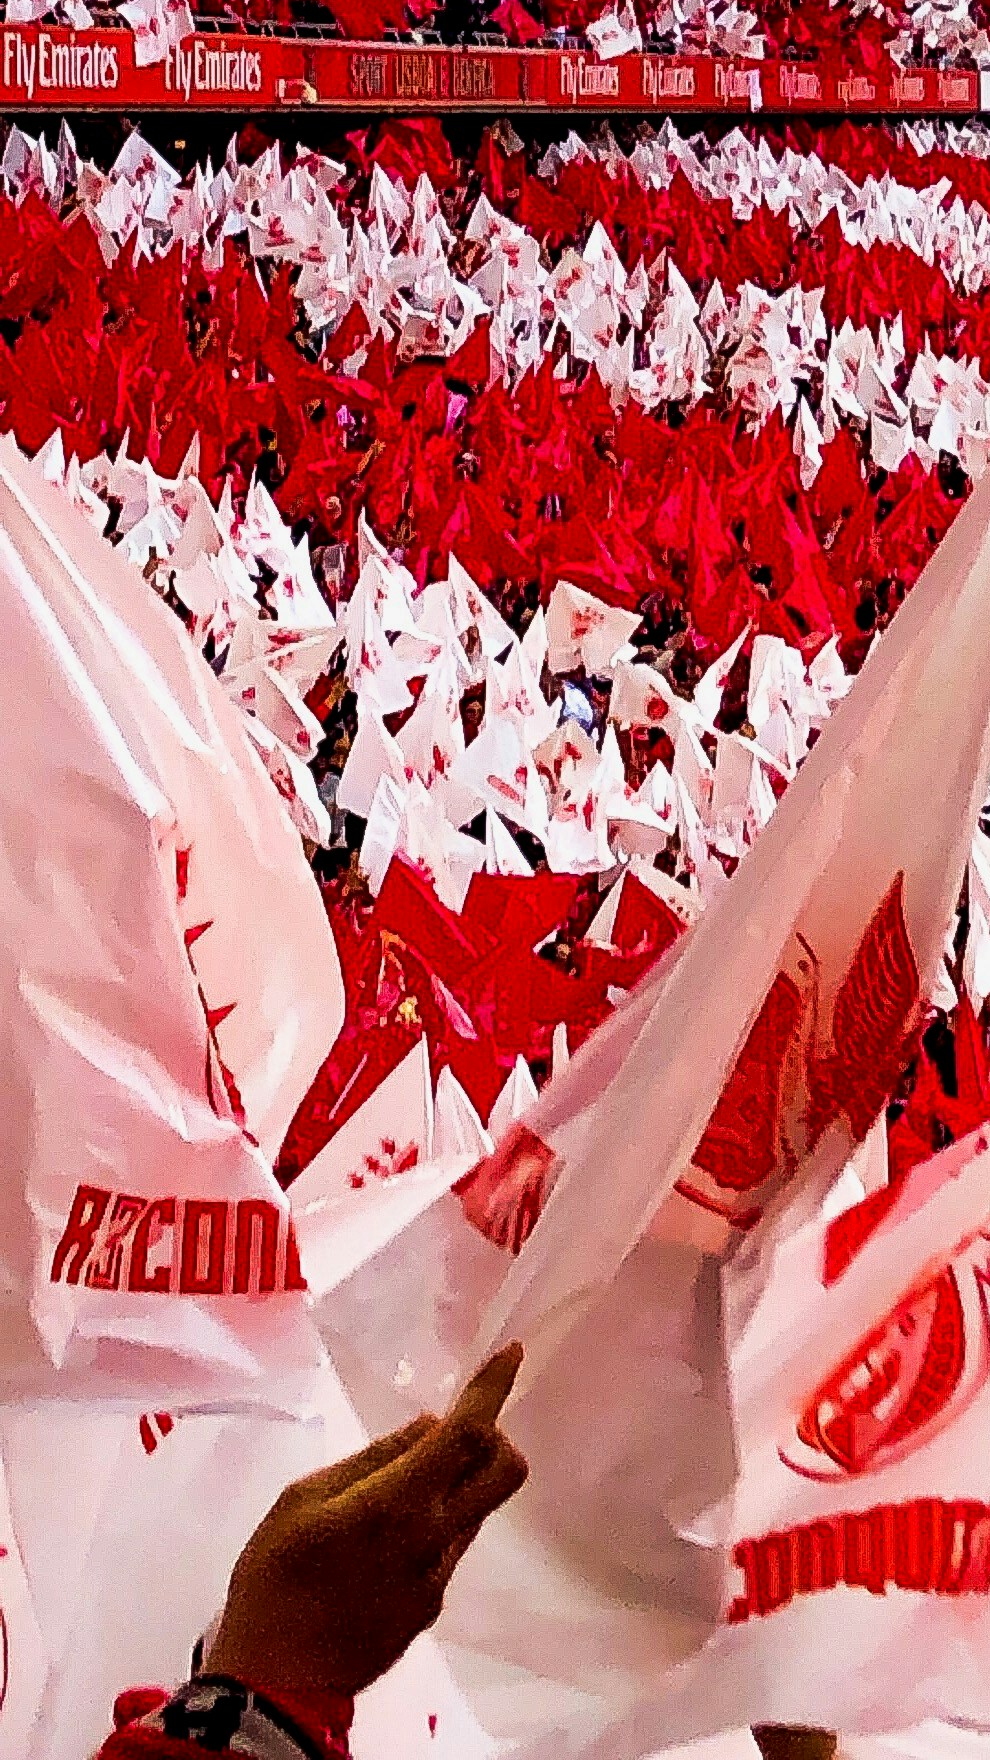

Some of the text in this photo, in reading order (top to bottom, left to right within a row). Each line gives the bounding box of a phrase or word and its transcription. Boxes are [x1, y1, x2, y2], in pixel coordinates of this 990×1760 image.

[3, 33, 119, 100] Fly Emirates
[165, 38, 262, 102] Fly Emirates
